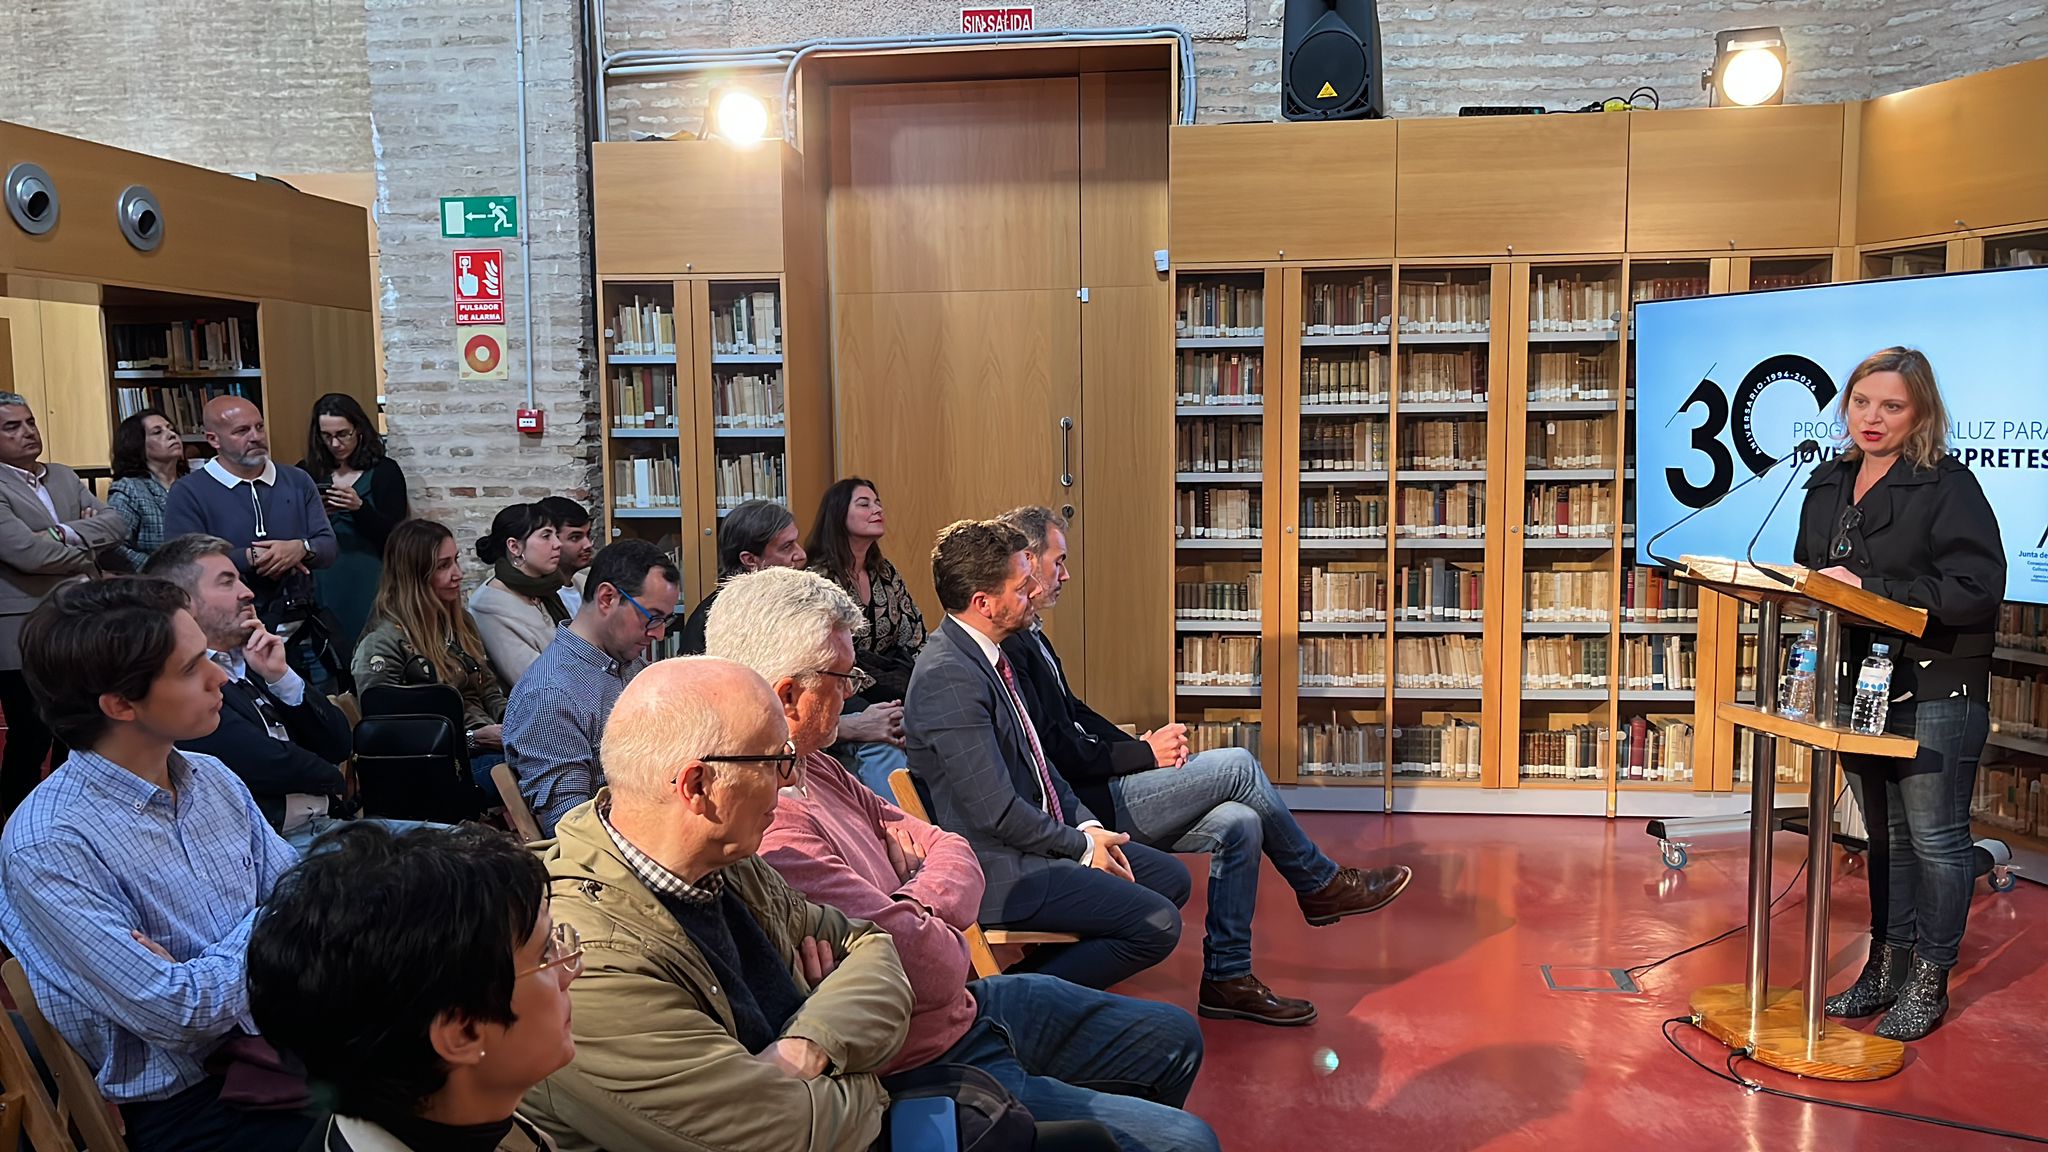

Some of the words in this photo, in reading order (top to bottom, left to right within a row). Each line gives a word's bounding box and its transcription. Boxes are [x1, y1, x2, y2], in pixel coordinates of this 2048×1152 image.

[964, 15, 985, 33] SIN
[987, 14, 1031, 33] SALIDA
[1793, 421, 1842, 438] PROG
[2018, 550, 2038, 558] Junta
